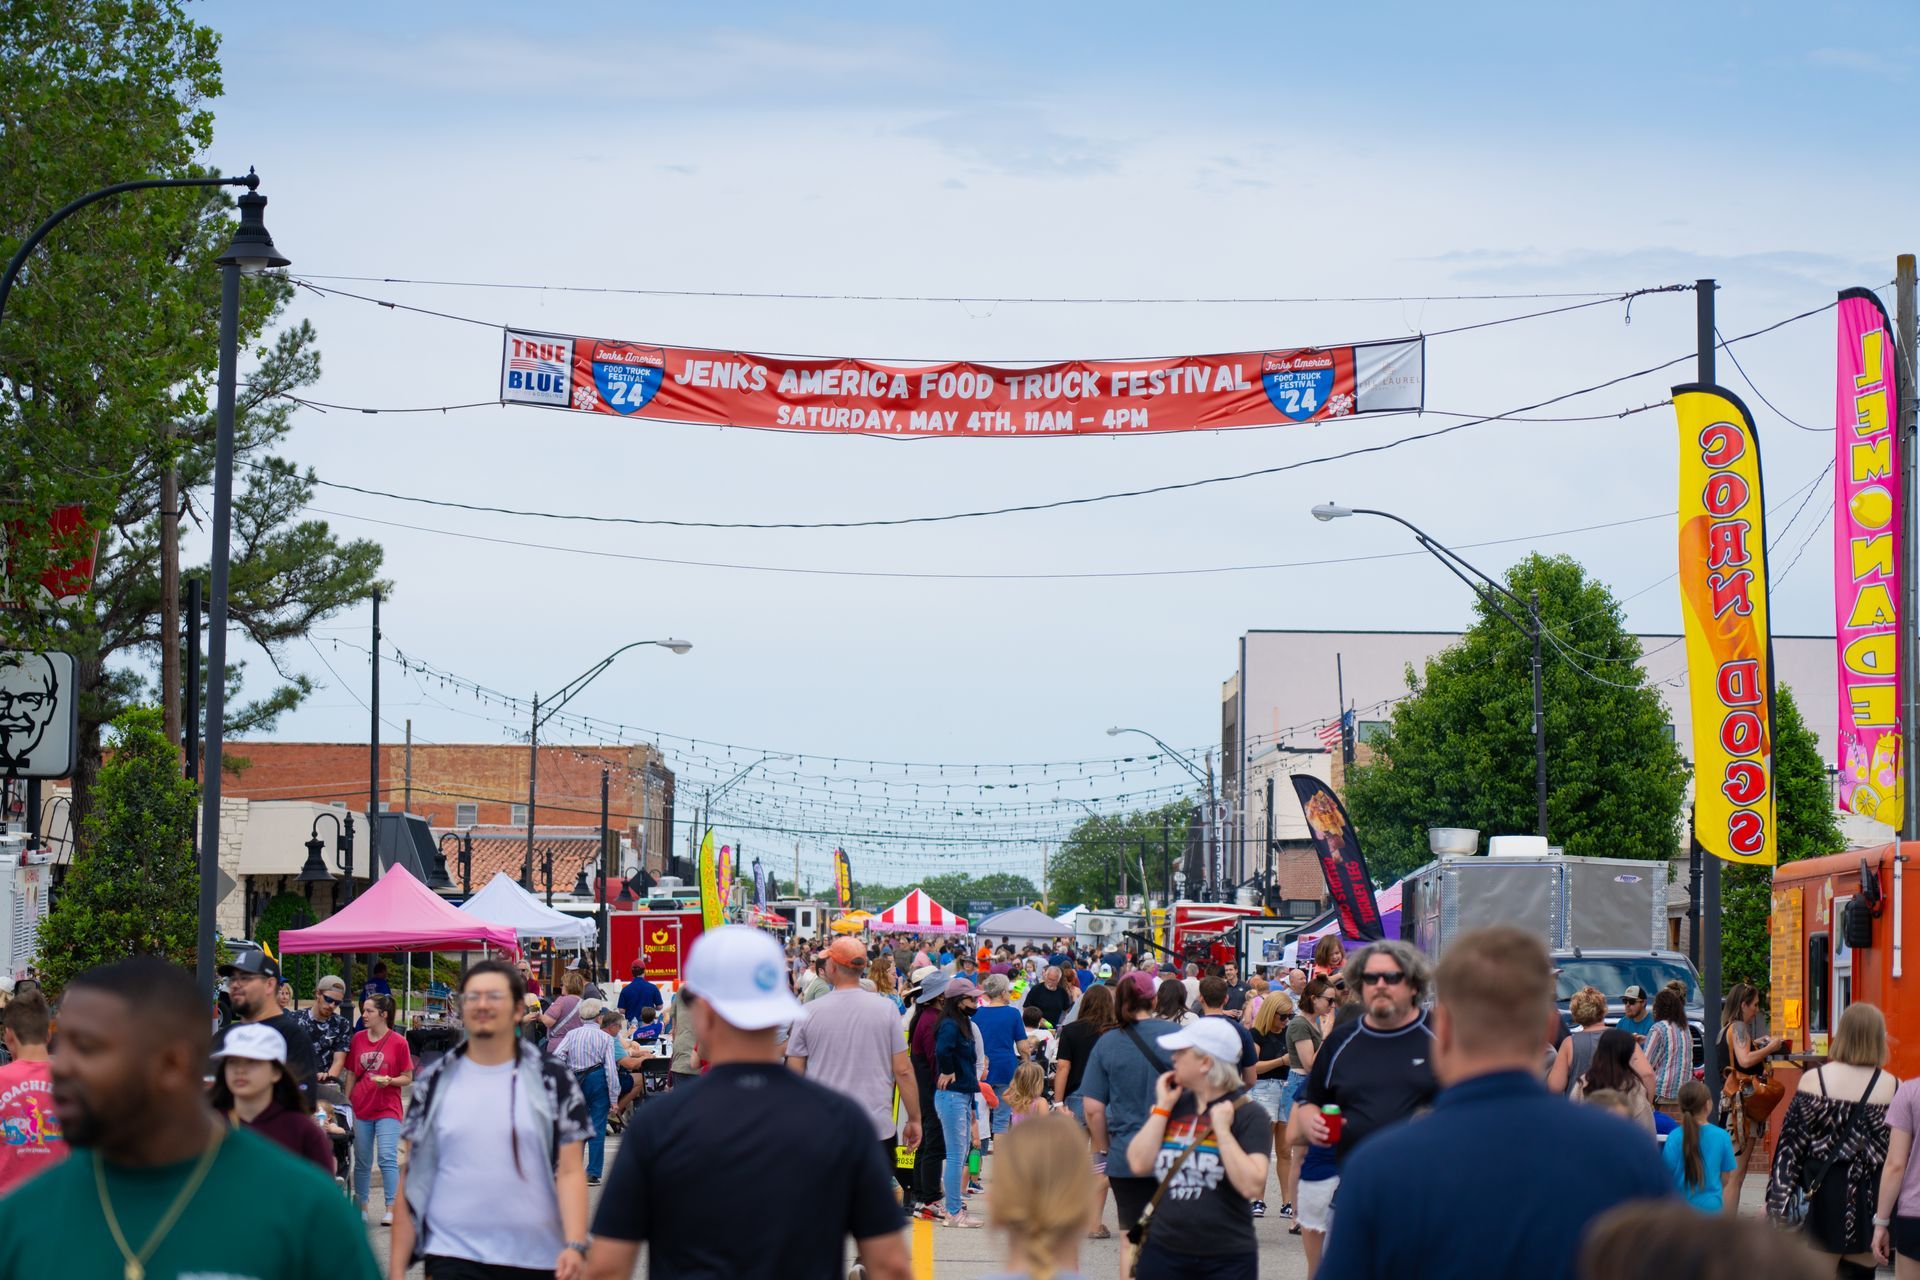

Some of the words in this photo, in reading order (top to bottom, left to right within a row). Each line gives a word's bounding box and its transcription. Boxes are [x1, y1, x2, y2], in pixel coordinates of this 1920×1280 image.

[512, 339, 565, 363] TRUE
[596, 349, 623, 361] Jenks
[625, 351, 662, 365] America
[604, 365, 623, 374] FOOD
[625, 366, 650, 376] TRUCK
[1265, 362, 1292, 371] Jenks
[1294, 358, 1332, 368] America
[508, 371, 565, 393] BLUE
[608, 373, 644, 383] FESTIVAL
[674, 359, 767, 391] JENKS
[777, 369, 909, 399] AMERICA
[920, 371, 994, 399] FOOD
[1004, 370, 1100, 400] TRUCK
[1110, 364, 1251, 396] FESTIVAL
[1274, 373, 1294, 382] FOOD
[1296, 372, 1321, 381] TRUCK
[1279, 379, 1316, 389] FESTIVAL
[1383, 376, 1421, 385] LAUREL
[776, 405, 902, 432] SATURDAY,
[909, 411, 959, 431] MAY
[966, 411, 1017, 433] 4TH,
[1024, 411, 1073, 431] 11AM
[1102, 408, 1149, 430] 4PM
[1344, 860, 1363, 881] LEG
[1352, 883, 1377, 924] TURKEY
[1170, 1187, 1203, 1200] 1977
